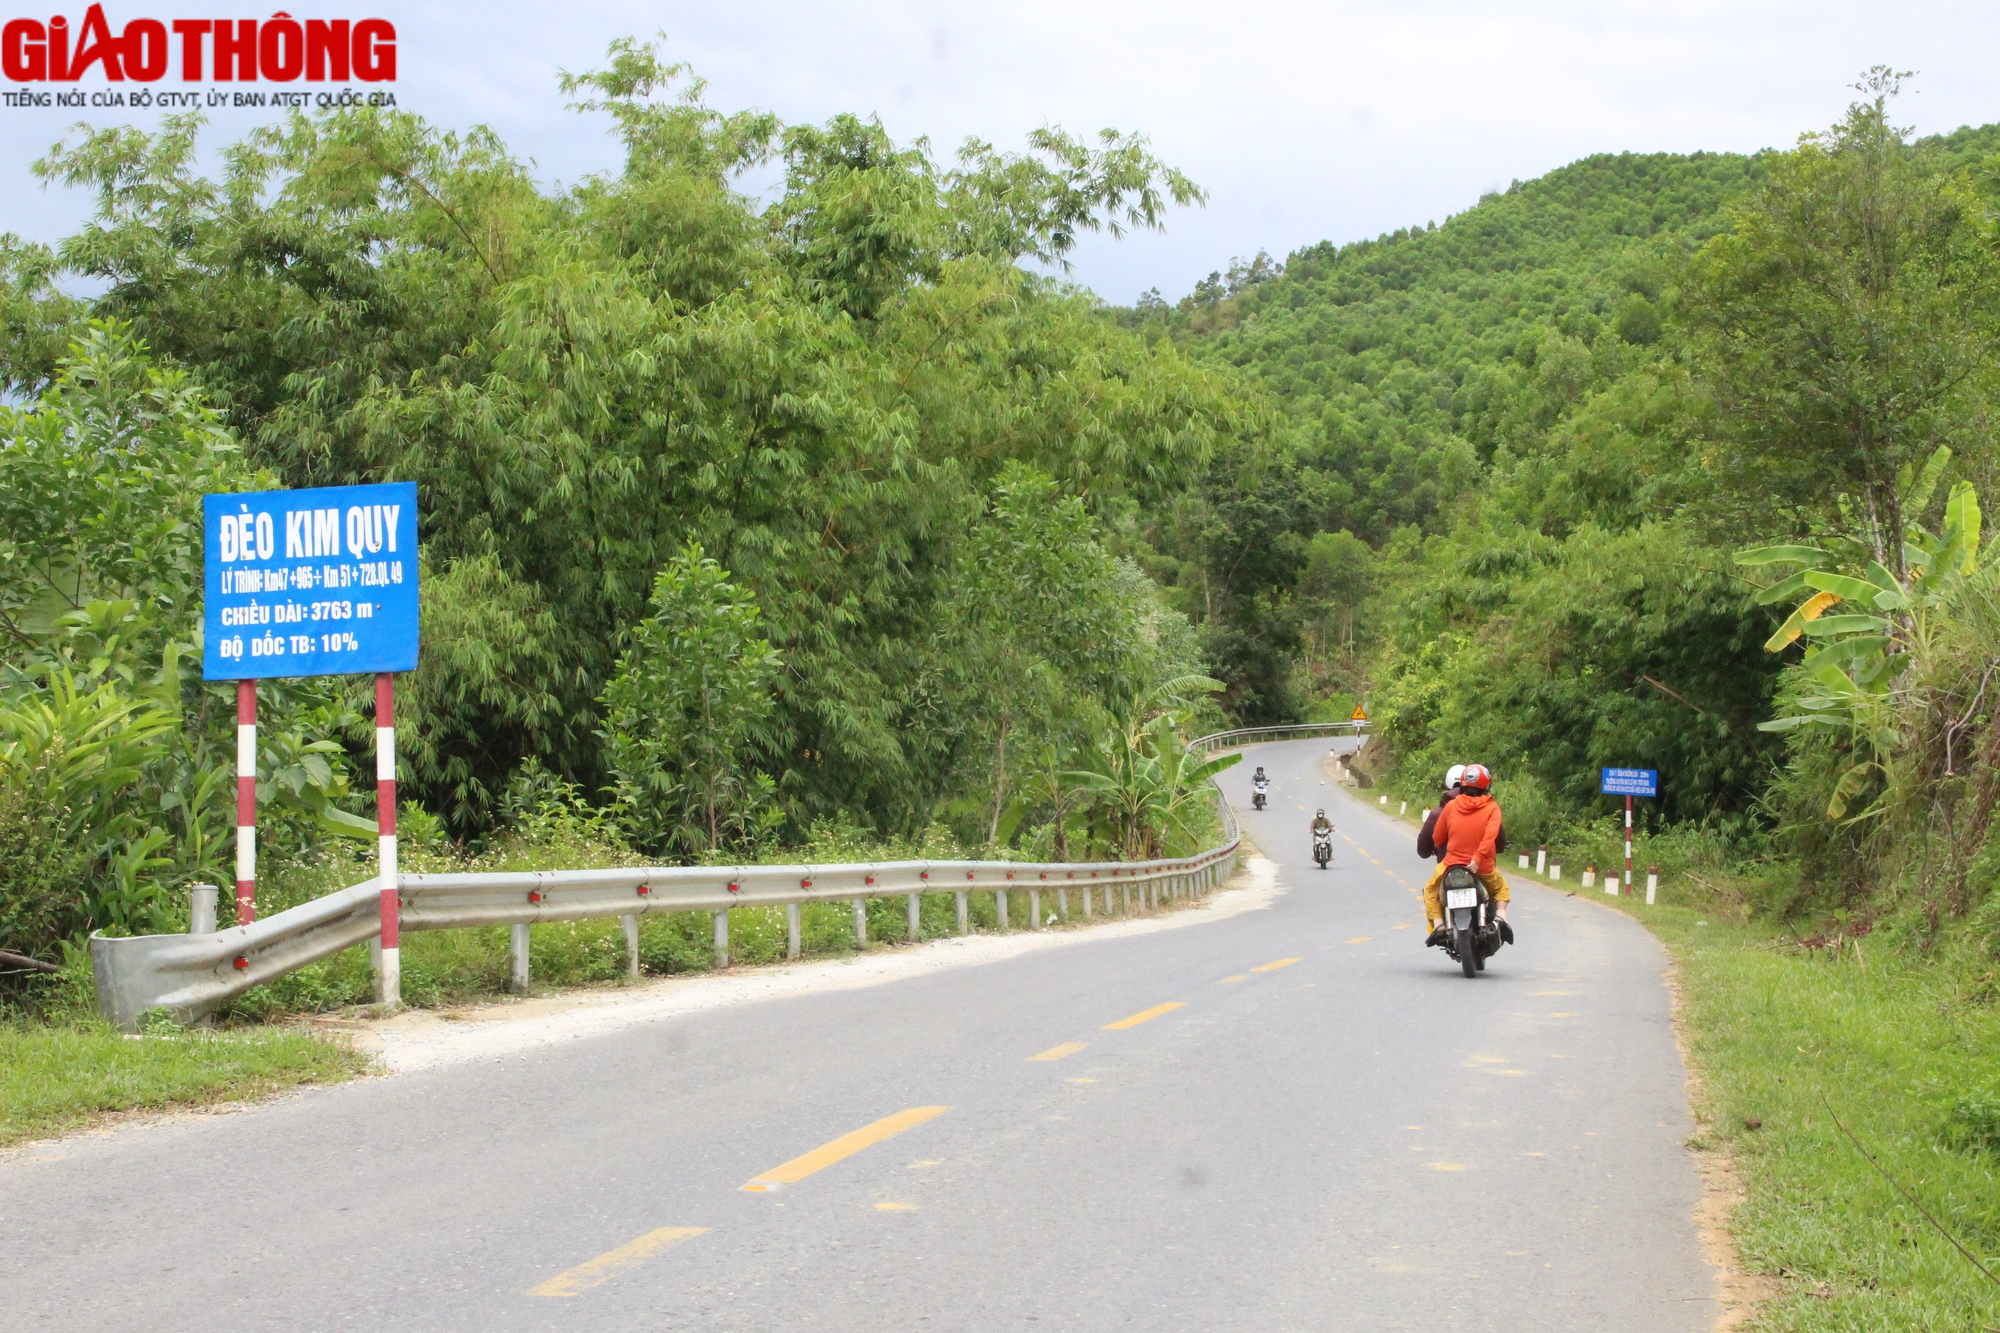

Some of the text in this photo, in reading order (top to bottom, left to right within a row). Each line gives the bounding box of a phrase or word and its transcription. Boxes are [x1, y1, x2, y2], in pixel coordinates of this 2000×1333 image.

[219, 503, 401, 563] ĐÈO KIM QUY
[221, 566, 232, 595] LÝ
[234, 565, 263, 594] TRÌNH:
[324, 565, 340, 589] Km
[391, 561, 403, 585] 49
[221, 599, 373, 626] CHIỀU DÀI: 3763 m
[220, 630, 358, 662] ĐỘ DỐC TB: 10%
